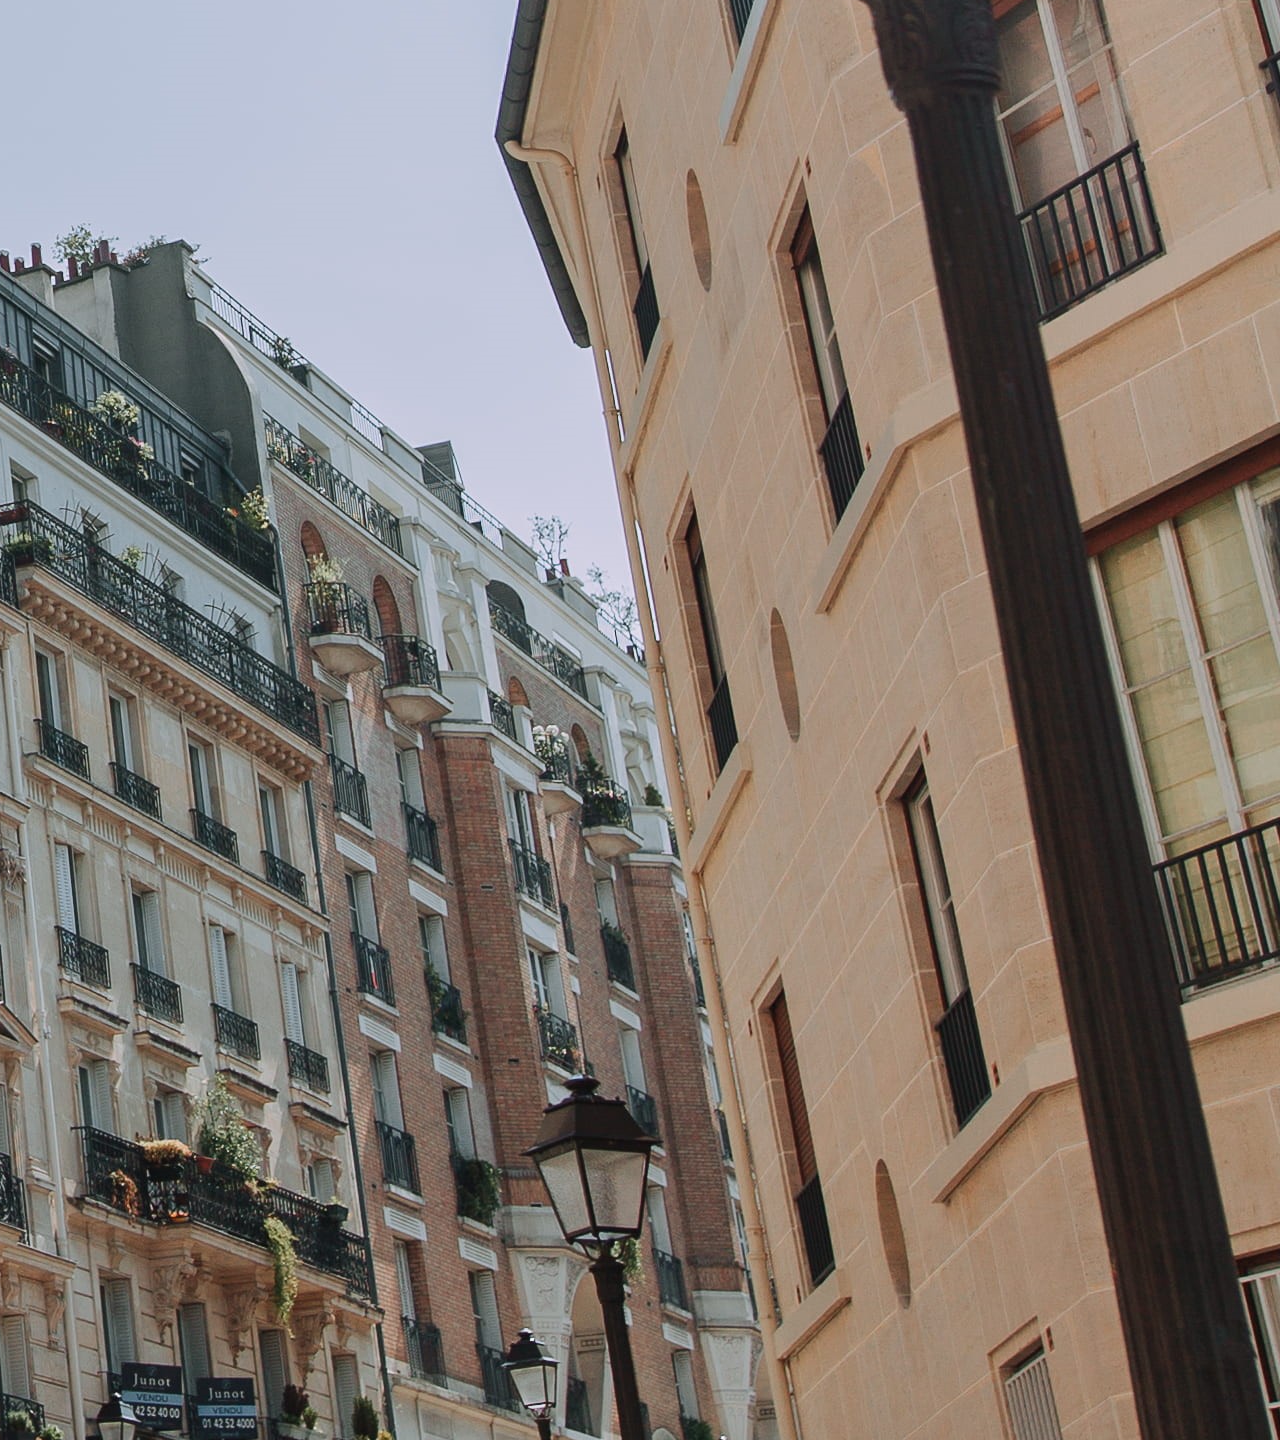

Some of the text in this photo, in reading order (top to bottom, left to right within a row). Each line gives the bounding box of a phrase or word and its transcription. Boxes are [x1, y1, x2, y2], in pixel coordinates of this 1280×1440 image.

[132, 1373, 171, 1387] Junot
[136, 1393, 169, 1403] VENDU
[209, 1387, 245, 1401] Junot
[135, 1406, 180, 1419] 42 52 40 00
[202, 1419, 212, 1428] 01
[213, 1419, 223, 1428] 42
[225, 1419, 235, 1428] 52
